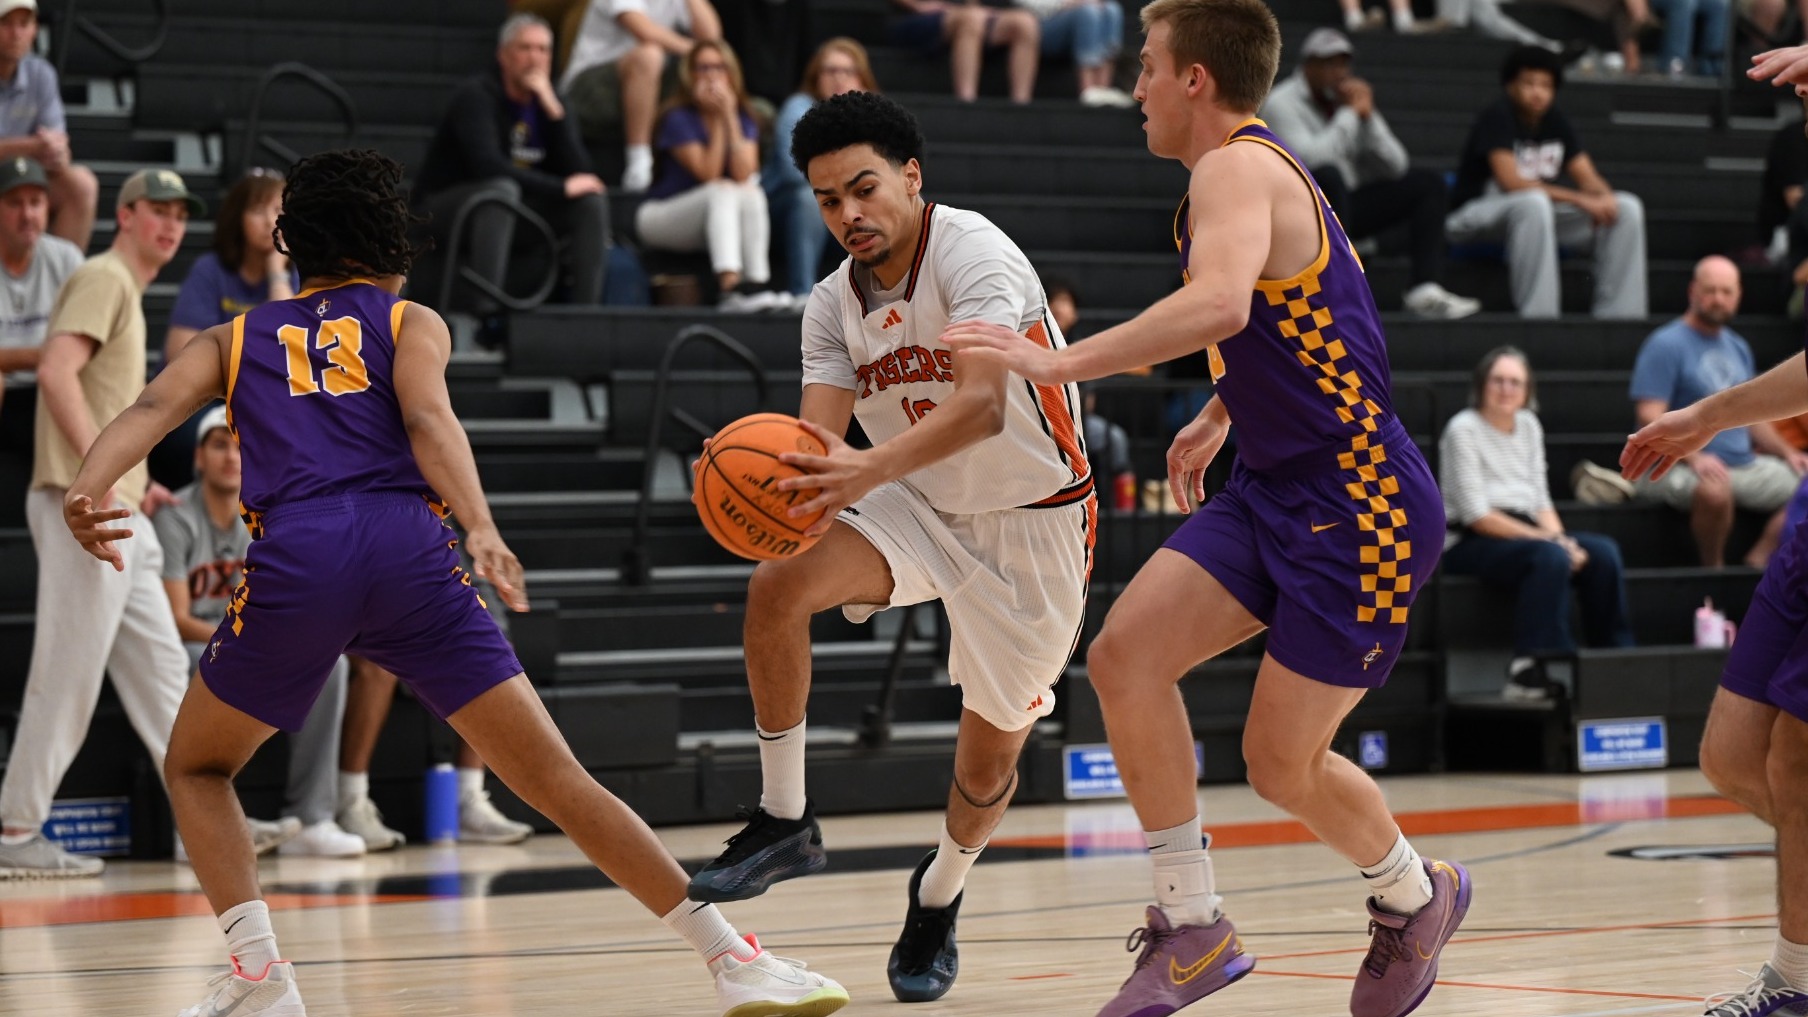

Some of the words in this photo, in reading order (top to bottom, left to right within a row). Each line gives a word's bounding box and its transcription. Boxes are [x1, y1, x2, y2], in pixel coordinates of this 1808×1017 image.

[276, 315, 372, 397] 13
[856, 344, 954, 399] TIGERS
[718, 494, 801, 555] Wilson
[190, 559, 245, 600] OX
